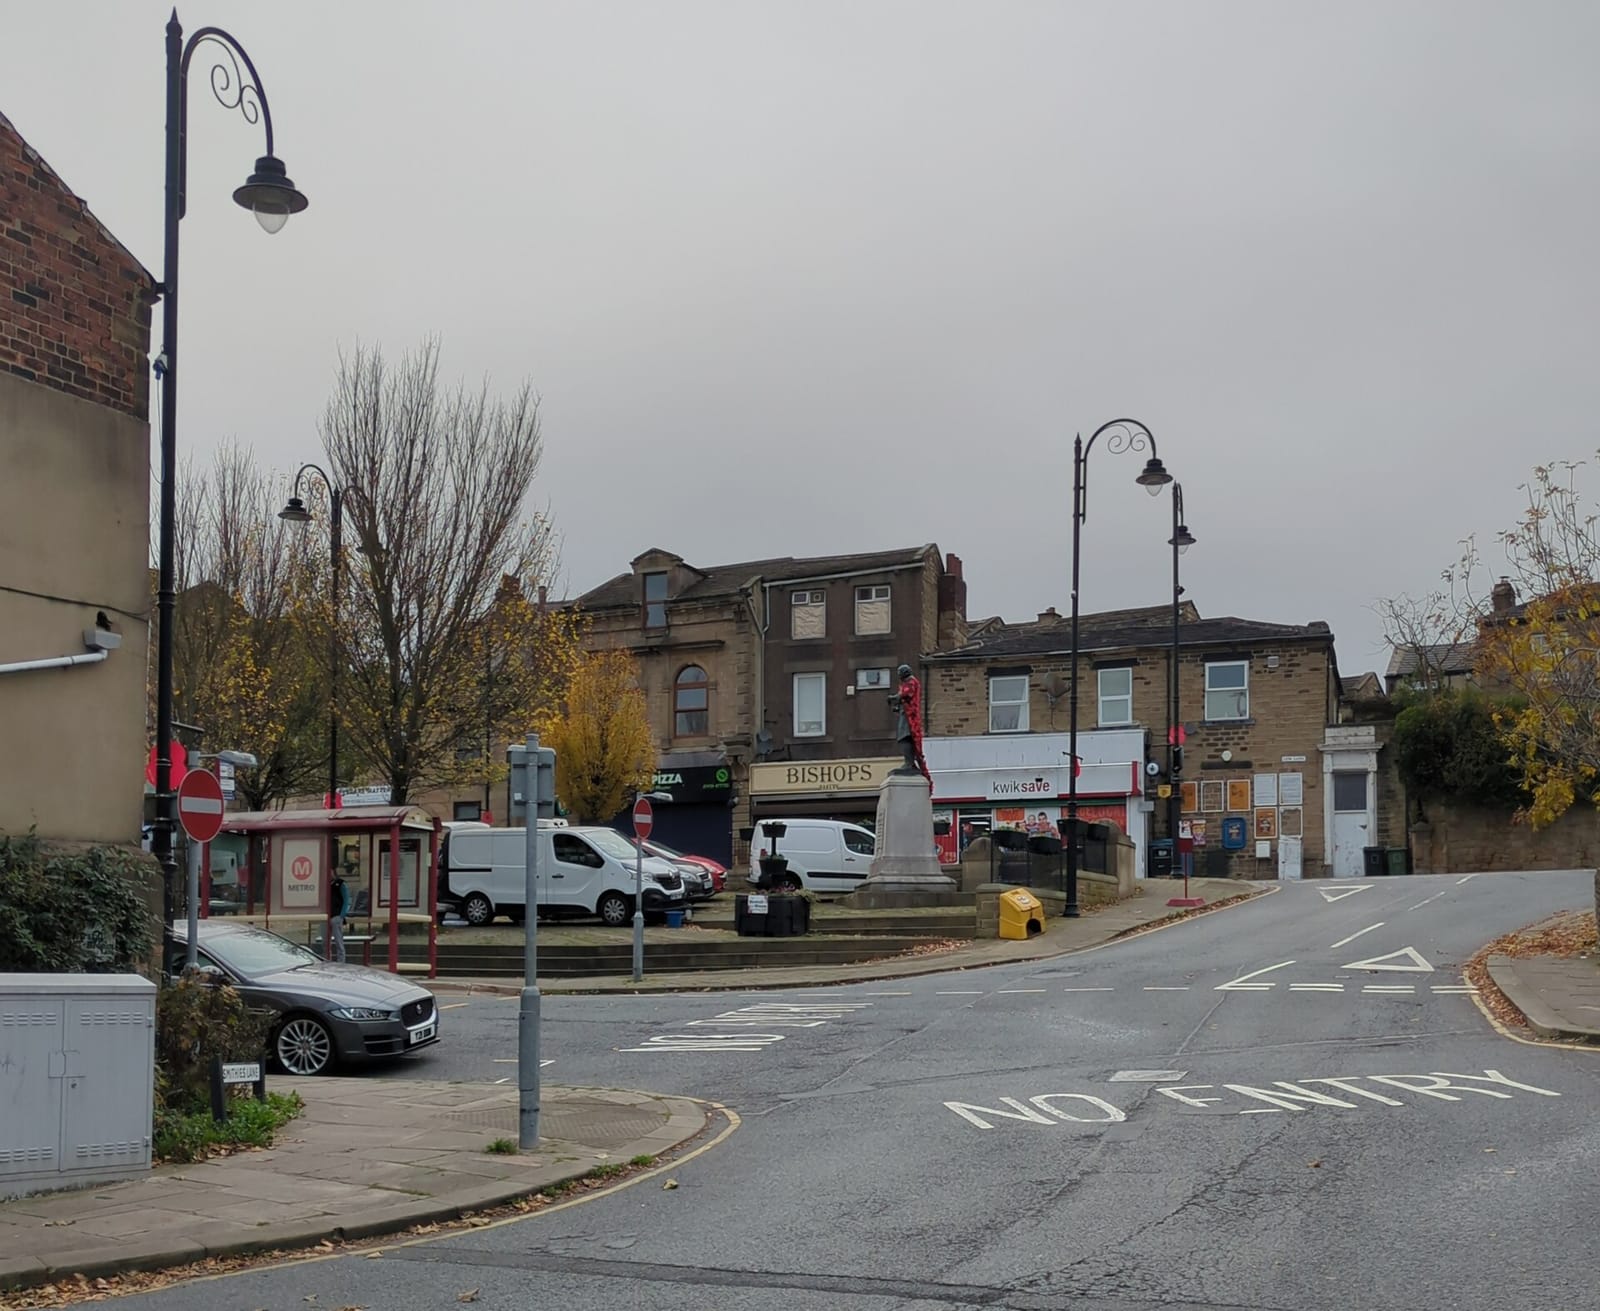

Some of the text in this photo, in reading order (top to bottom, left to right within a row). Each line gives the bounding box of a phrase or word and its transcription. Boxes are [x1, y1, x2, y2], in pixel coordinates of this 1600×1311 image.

[786, 764, 873, 784] BISHOPS
[992, 779, 1050, 794] kwiksave
[288, 884, 316, 892] METRO
[943, 1069, 1562, 1130] NO ENTRY
